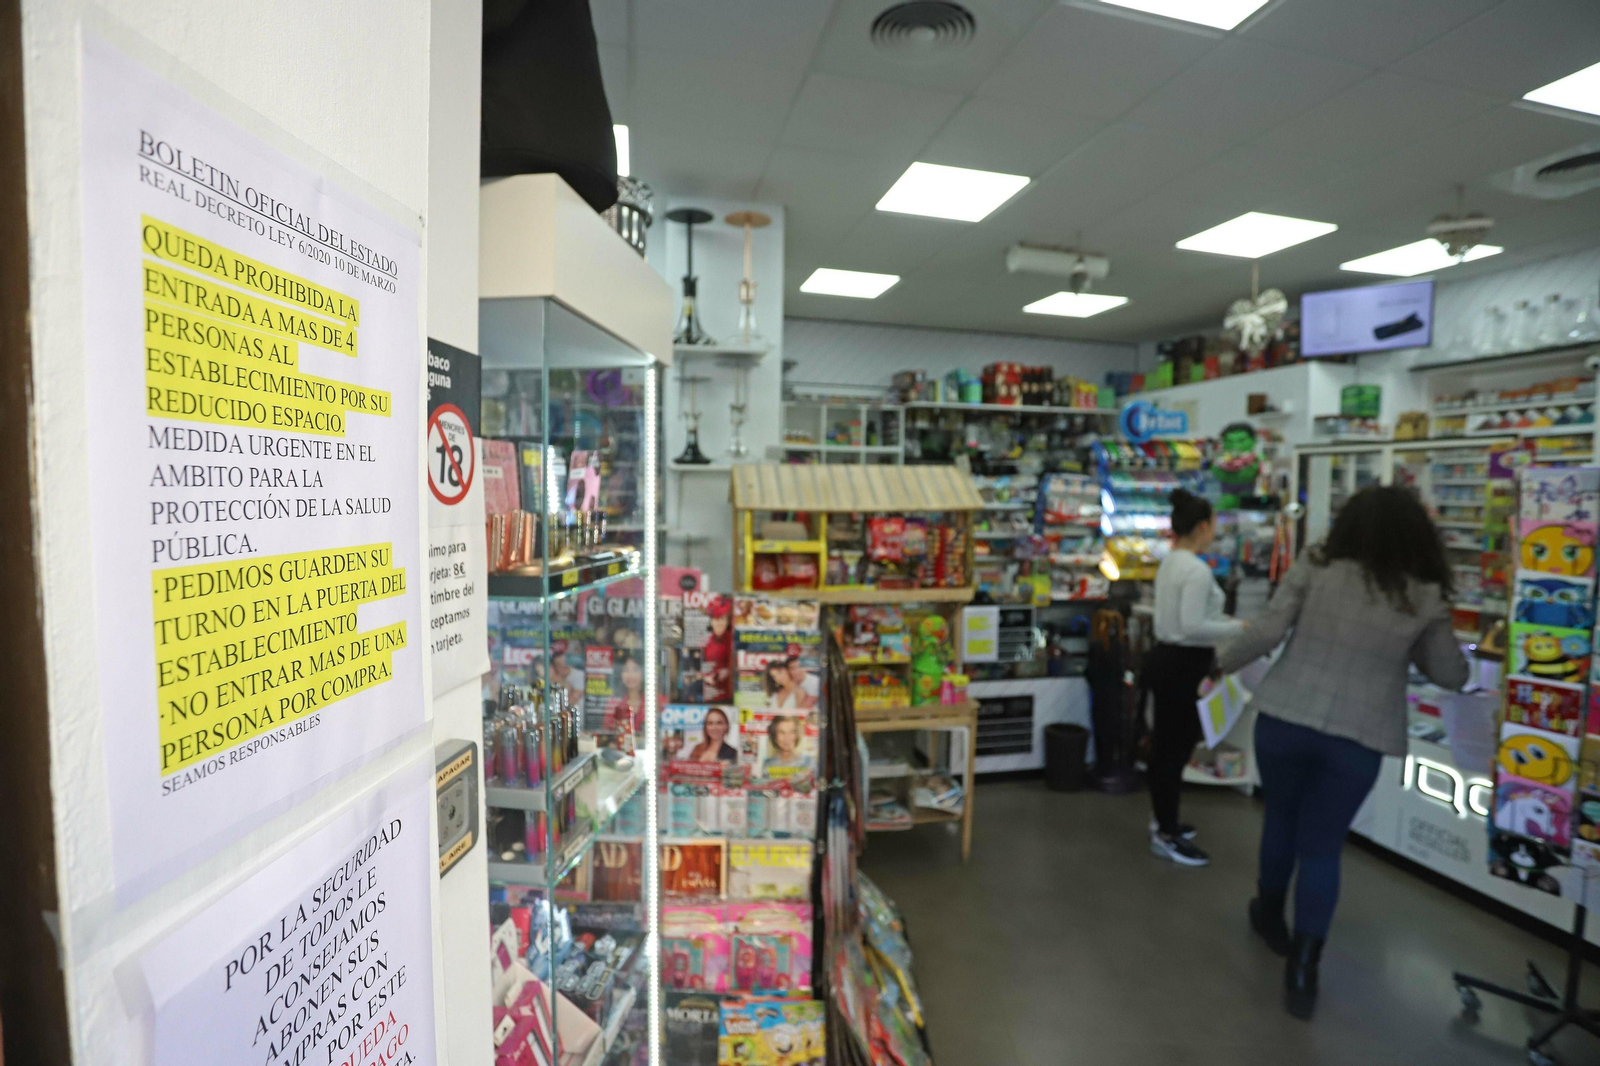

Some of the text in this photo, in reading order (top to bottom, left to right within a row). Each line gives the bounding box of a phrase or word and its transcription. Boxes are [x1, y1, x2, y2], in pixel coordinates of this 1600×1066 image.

[139, 129, 398, 277] BOLETIN OFICIAL DEL ESTADO
[139, 165, 396, 295] REAL DECRETO LEY 6/2020 10 DE MARZO
[143, 223, 357, 322] QUEDA PROHIBIDA LA
[143, 267, 354, 351] ENTRADA A MAS DE 4
[145, 308, 294, 366] PERSONAS AL
[146, 348, 388, 412] ESTABLECIMIENTO POR SU
[147, 386, 345, 433] REDUCIDO ESPACIO.
[148, 425, 376, 462] MEDIDA URGENTE EN EL
[436, 444, 463, 487] 18
[448, 433, 456, 442] DE
[150, 463, 323, 488] AMBITO PARA LA
[150, 494, 391, 525] PROTECCIÓN DE LA SALUD
[152, 531, 257, 563] PÚBLICA.
[279, 551, 367, 583] GUARDEN
[371, 548, 389, 568] SU
[429, 542, 466, 558] imo para
[453, 562, 466, 576] 8€
[154, 573, 406, 645] TURNO EN LA PUERTA DEL
[430, 582, 474, 605] timbre del
[157, 612, 357, 688] ESTABLECIMIENTO
[216, 658, 305, 709] ENTRAR
[309, 645, 346, 676] MAS
[350, 637, 370, 661] DE
[374, 628, 405, 653] UNA
[160, 661, 392, 770] PERSONA POR COMPRA.
[161, 713, 321, 797] SEAMOS RESPONSABLES
[449, 841, 466, 861] AIRE
[223, 818, 402, 994] POR LA SEGURIDAD
[265, 866, 378, 997] DE TODOS LE
[252, 892, 386, 1048] ACONSEJAMOS
[265, 930, 379, 1066] ABONEN SUS
[351, 951, 389, 1002] CON
[327, 966, 407, 1065] POR ESTE
